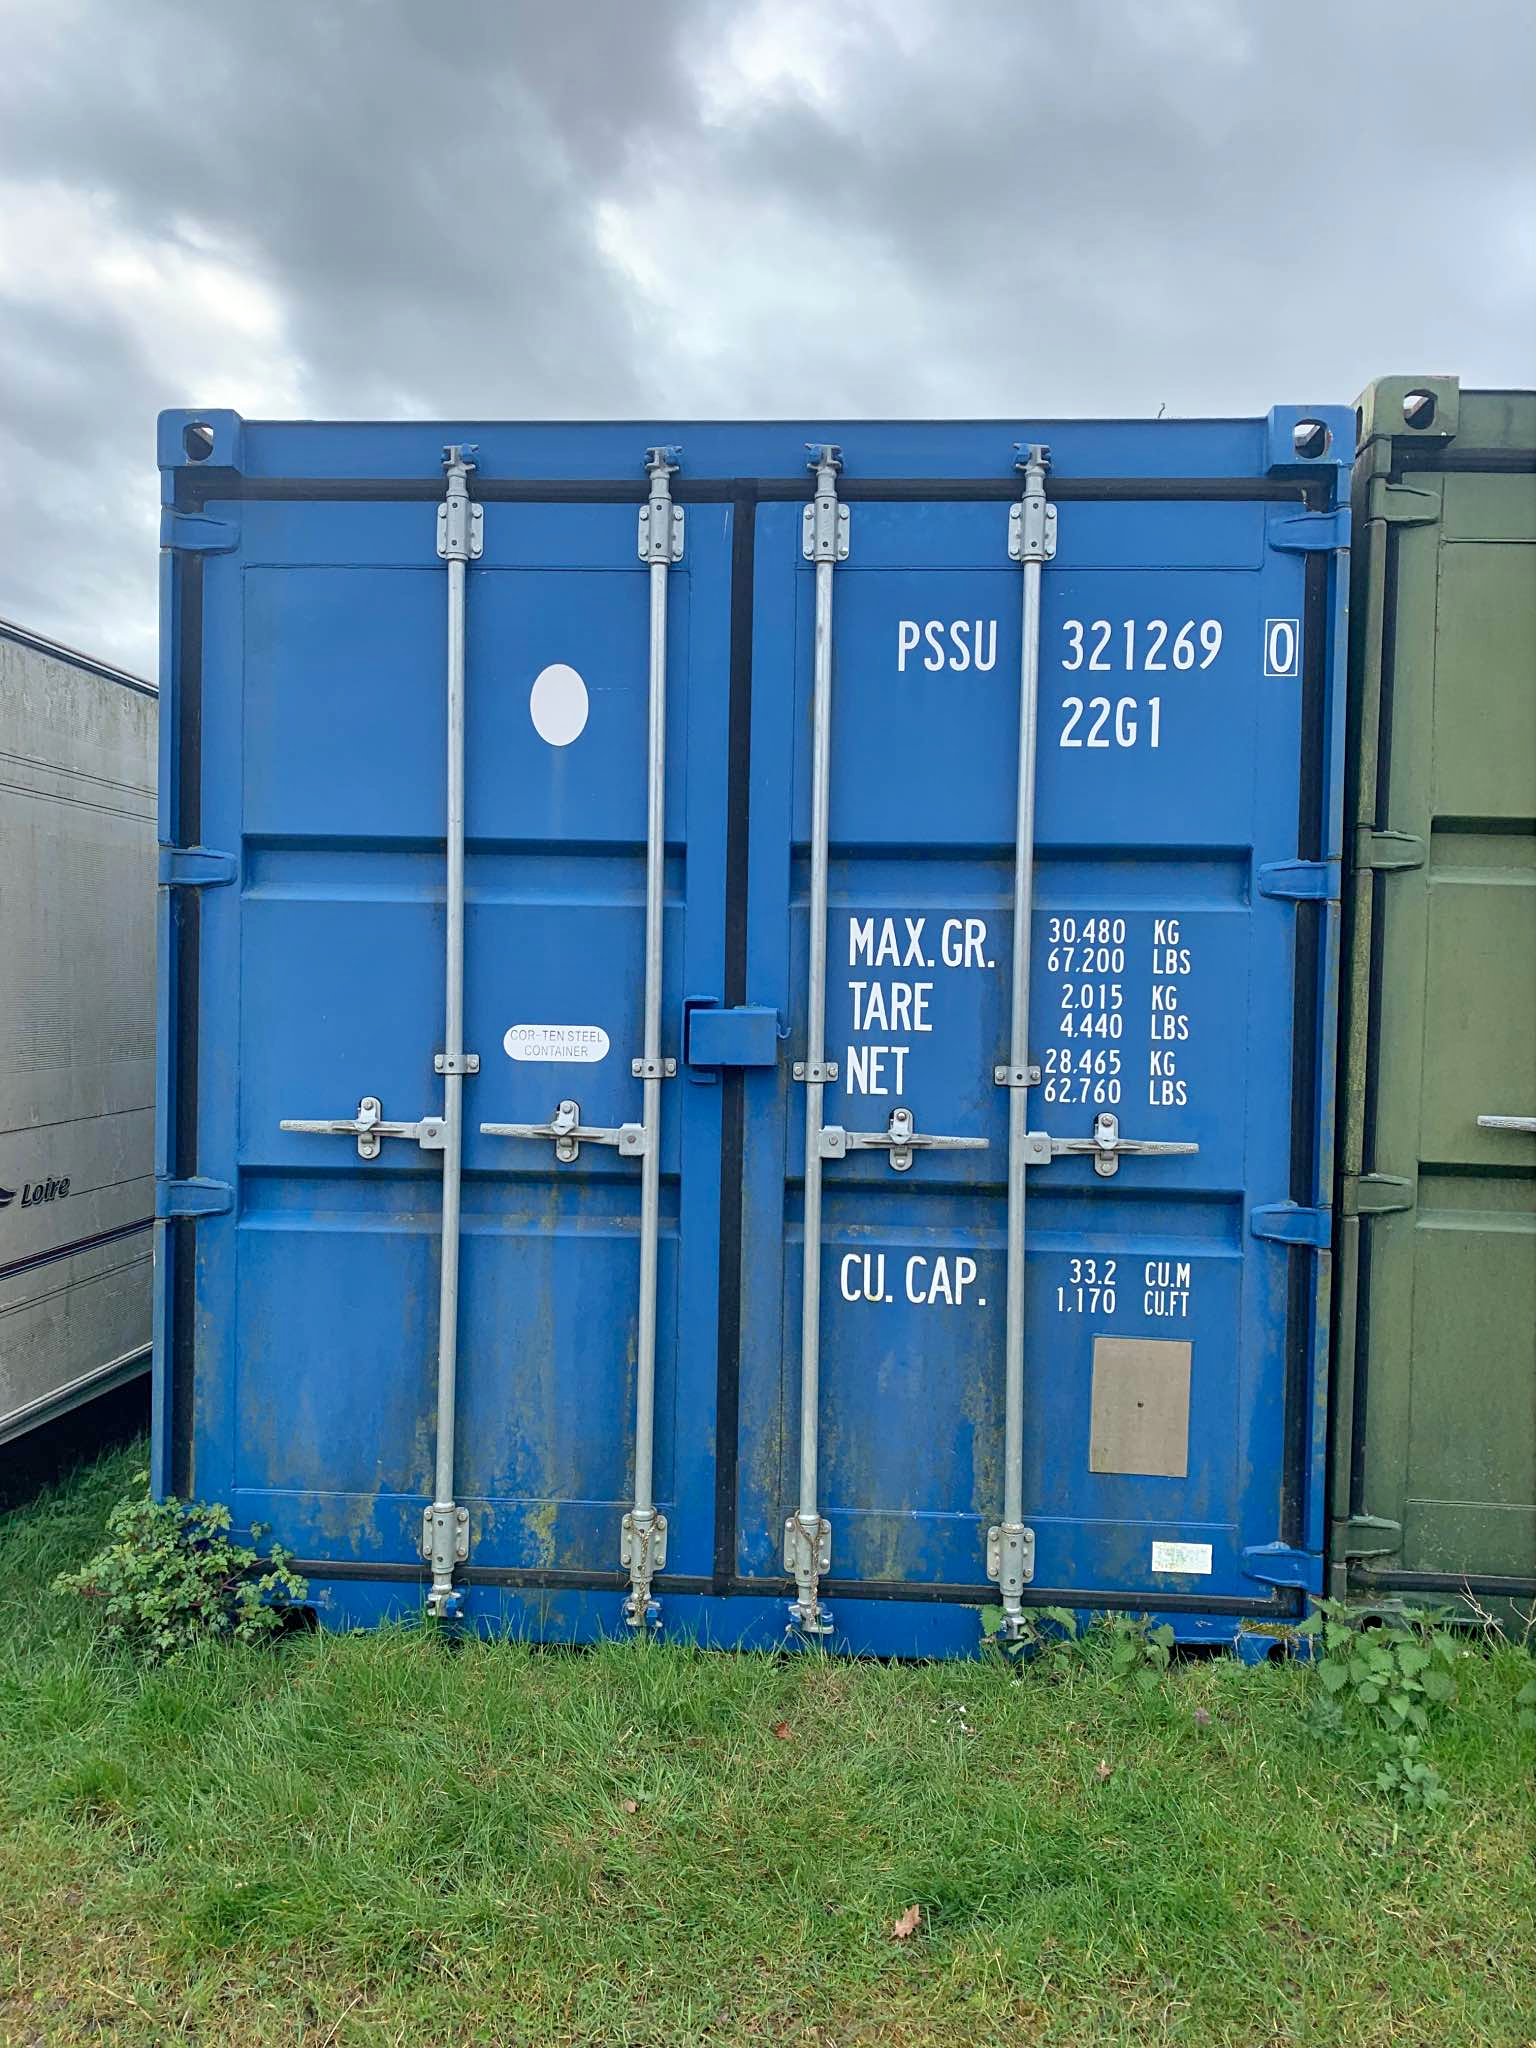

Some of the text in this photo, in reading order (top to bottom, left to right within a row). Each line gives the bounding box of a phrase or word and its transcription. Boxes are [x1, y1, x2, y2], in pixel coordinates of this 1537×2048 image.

[898, 620, 1295, 673] PSSU 321269 0
[1059, 696, 1160, 748] 22G1
[849, 918, 996, 968] MAX. GR.
[1153, 919, 1180, 945] KG
[1152, 948, 1191, 975] LBS
[848, 981, 934, 1032] TARE
[1151, 985, 1177, 1011] KG
[567, 1030, 603, 1042] STEEL
[1150, 1013, 1189, 1041] LBS
[524, 1045, 588, 1057] CONTAINER
[1150, 1050, 1175, 1077] KG
[846, 1045, 910, 1096] NET
[1149, 1079, 1187, 1106] LBS
[21, 1177, 71, 1208] Loire
[840, 1253, 987, 1306] CU. CAP.
[1069, 1258, 1191, 1289] 33.2 CU.M
[1144, 1290, 1190, 1317] CU.FT
